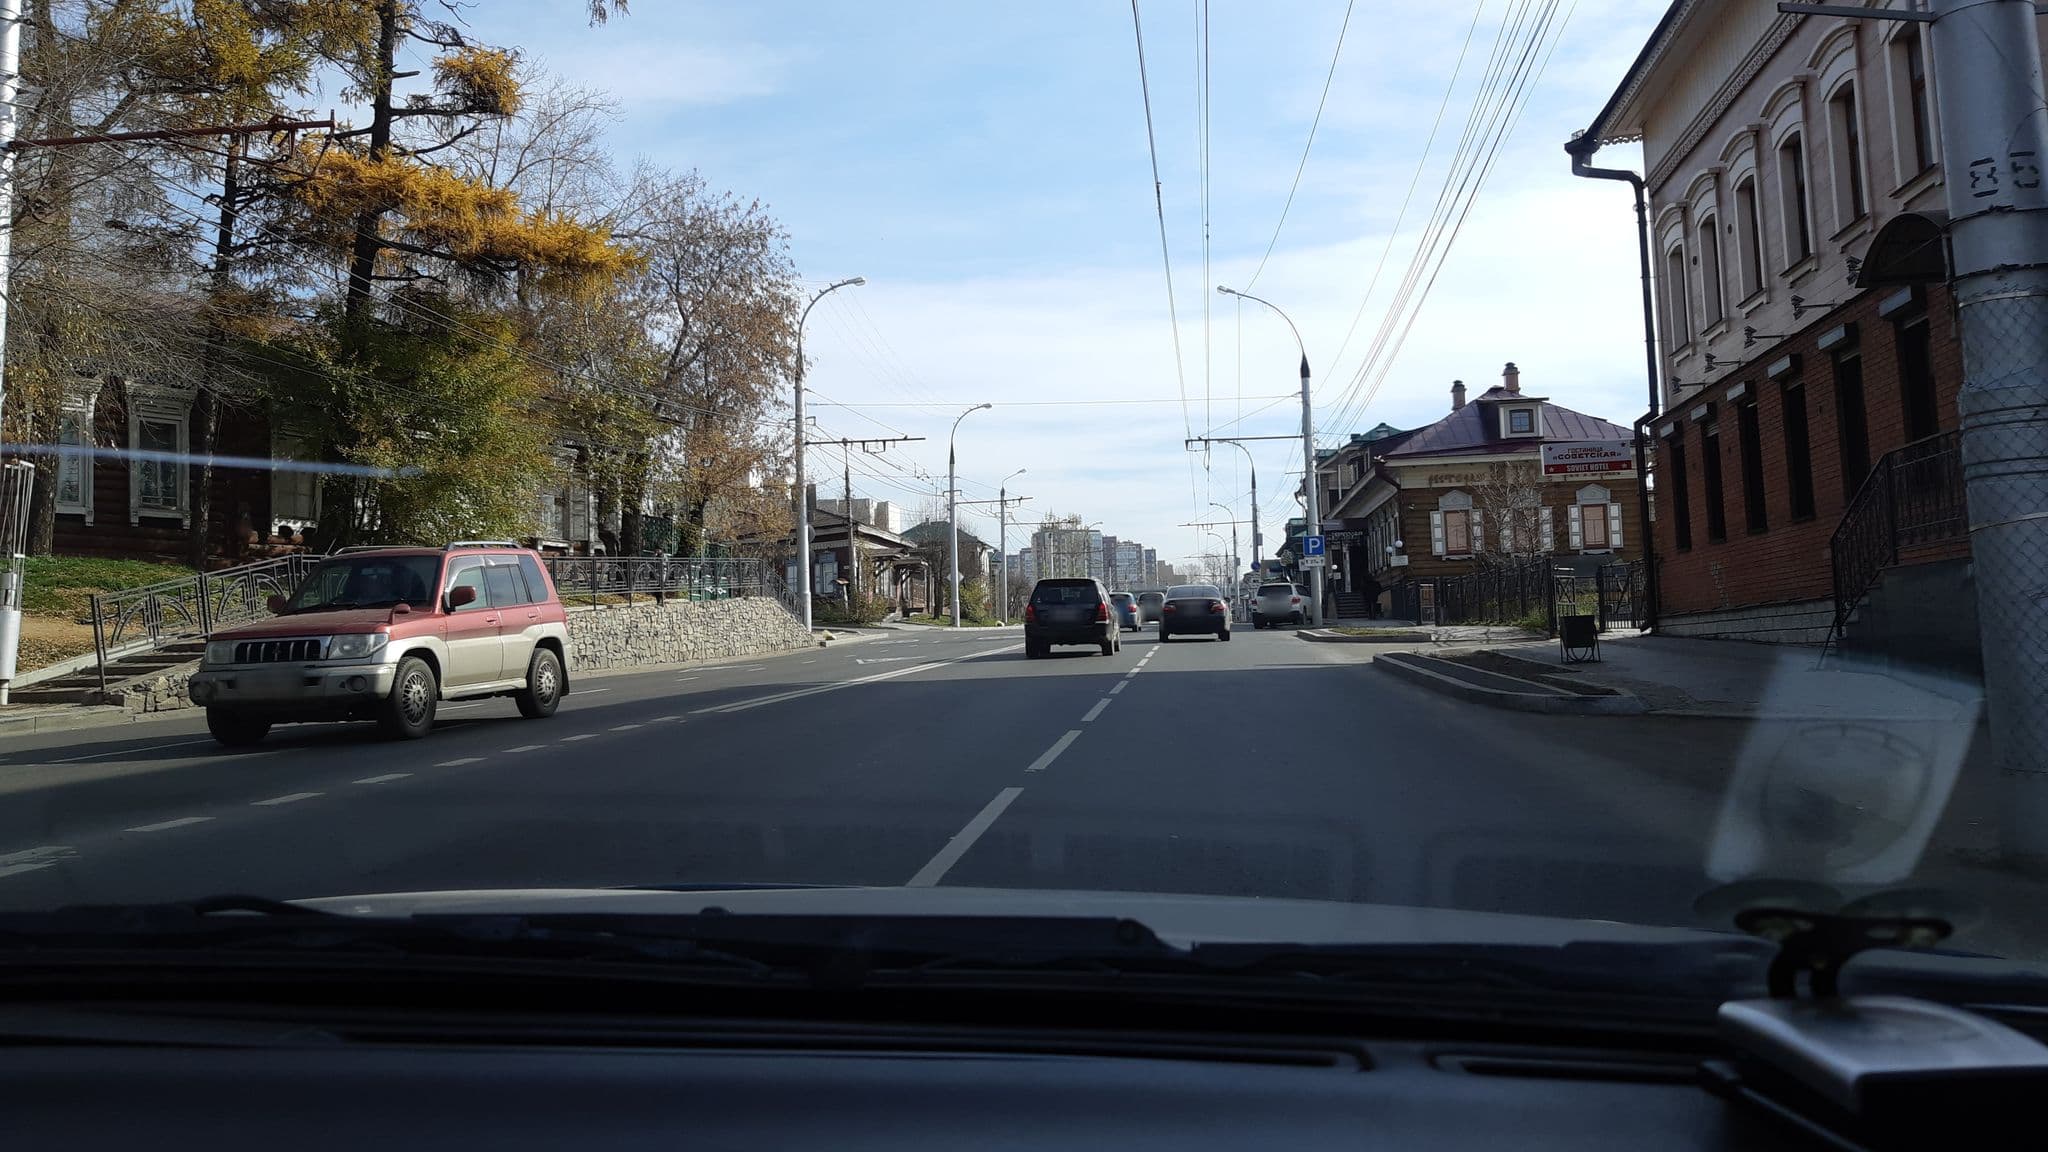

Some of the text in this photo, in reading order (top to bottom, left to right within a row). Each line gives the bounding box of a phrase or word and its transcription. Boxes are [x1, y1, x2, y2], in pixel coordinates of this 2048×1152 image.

[1568, 446, 1603, 454] ГОСТИНИЦА
[1567, 462, 1610, 472] SOVIET HOTEL
[1308, 537, 1320, 554] P
